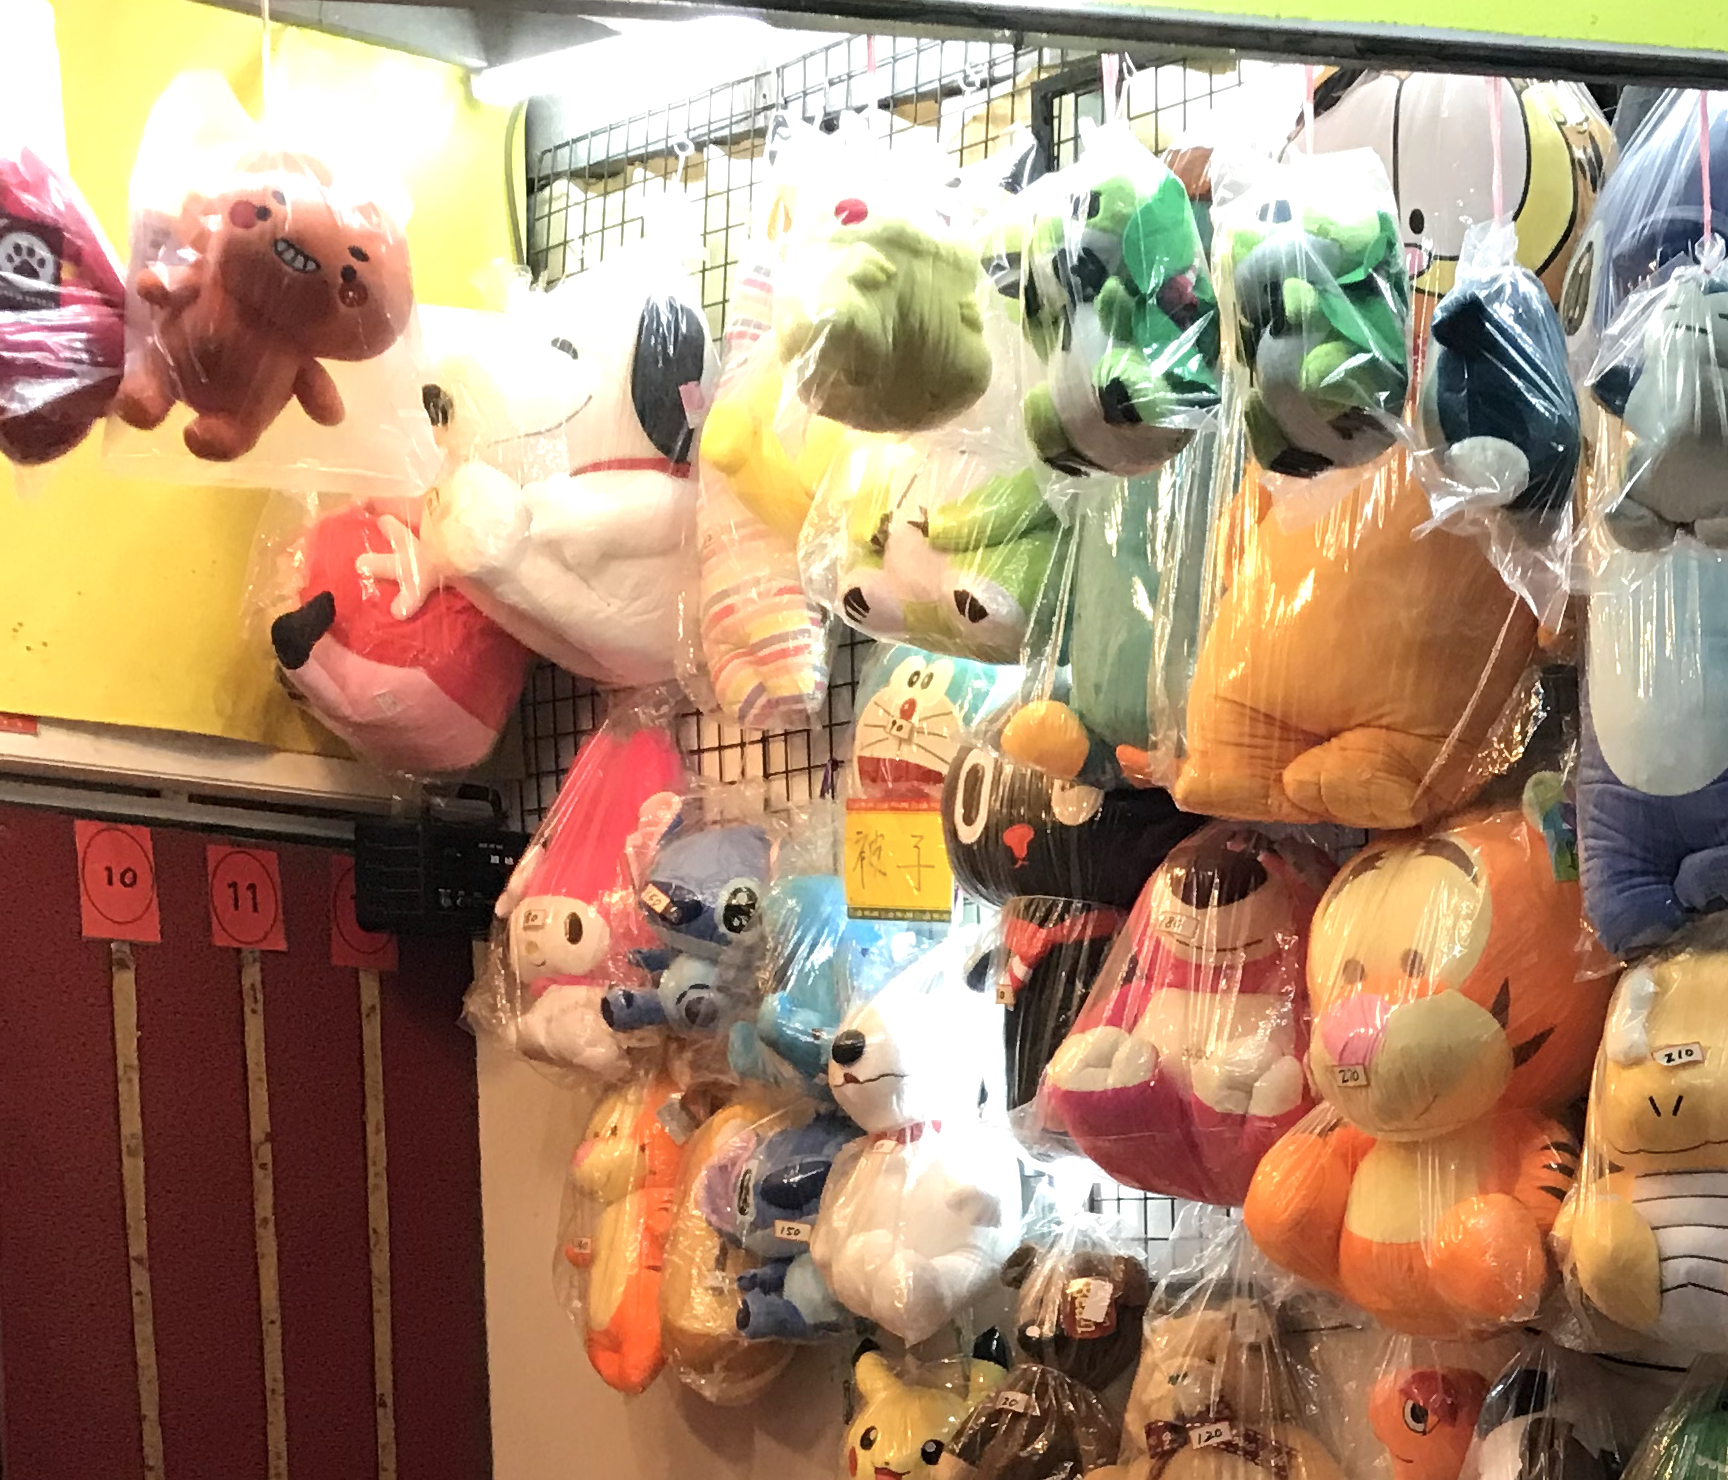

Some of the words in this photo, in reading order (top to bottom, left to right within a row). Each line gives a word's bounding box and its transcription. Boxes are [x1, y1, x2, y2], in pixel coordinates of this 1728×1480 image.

[104, 866, 138, 888] 10
[227, 880, 260, 913] 11
[1664, 1048, 1694, 1064] 210
[780, 1226, 801, 1237] 150
[1197, 1427, 1223, 1446] 120
